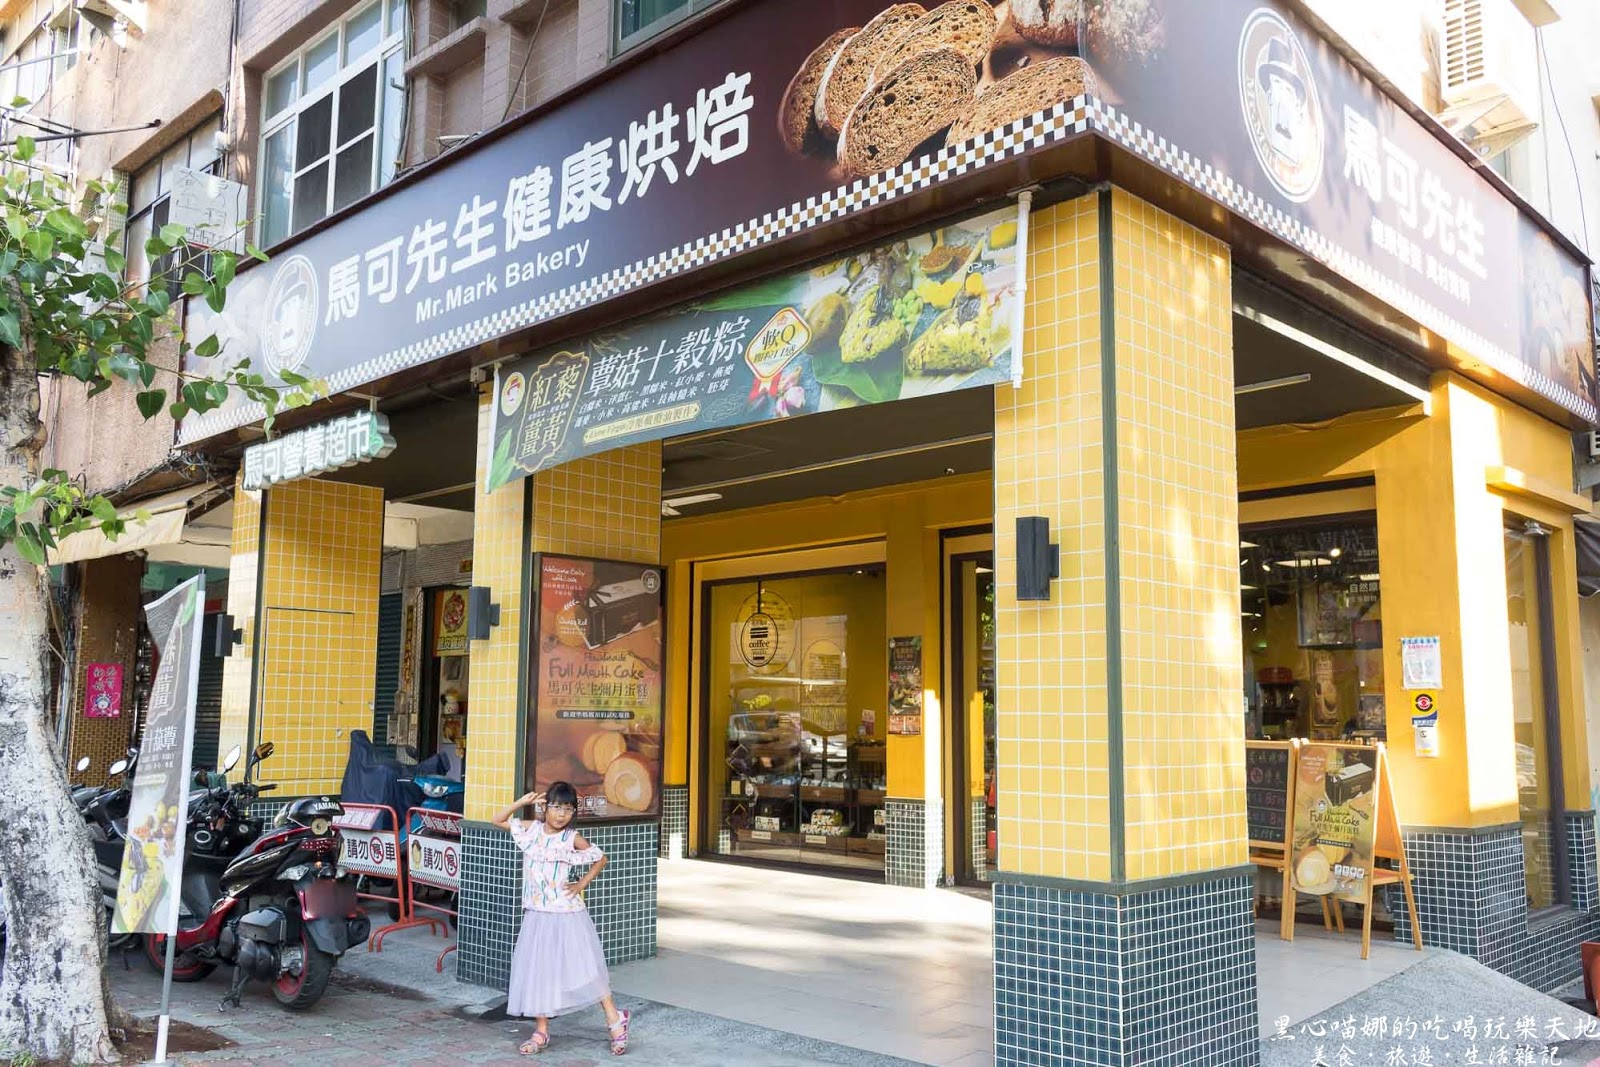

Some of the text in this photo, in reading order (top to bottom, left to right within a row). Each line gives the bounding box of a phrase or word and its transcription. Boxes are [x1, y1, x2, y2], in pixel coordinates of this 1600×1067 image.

[324, 72, 755, 326] 馬可先生健康烘焙
[1343, 103, 1488, 283] 馬可先生
[415, 239, 591, 324] Mr.Mark Bakery
[763, 324, 796, 350] 軟Q
[585, 318, 751, 397] 蕈菇十穀粽
[530, 363, 583, 411] 紅藜
[242, 410, 372, 490] 馬可營養超市
[519, 411, 567, 460] 薑黃
[749, 639, 770, 648] coffee
[549, 657, 573, 679] Full
[613, 660, 645, 680] Cake
[547, 680, 648, 699] 馬可先生彌月蛋糕
[313, 801, 341, 811] YAMAHA
[1309, 810, 1323, 822] Full
[1342, 815, 1360, 827] Cake
[346, 835, 396, 866] 請勿停車
[423, 846, 460, 878] 請勿停
